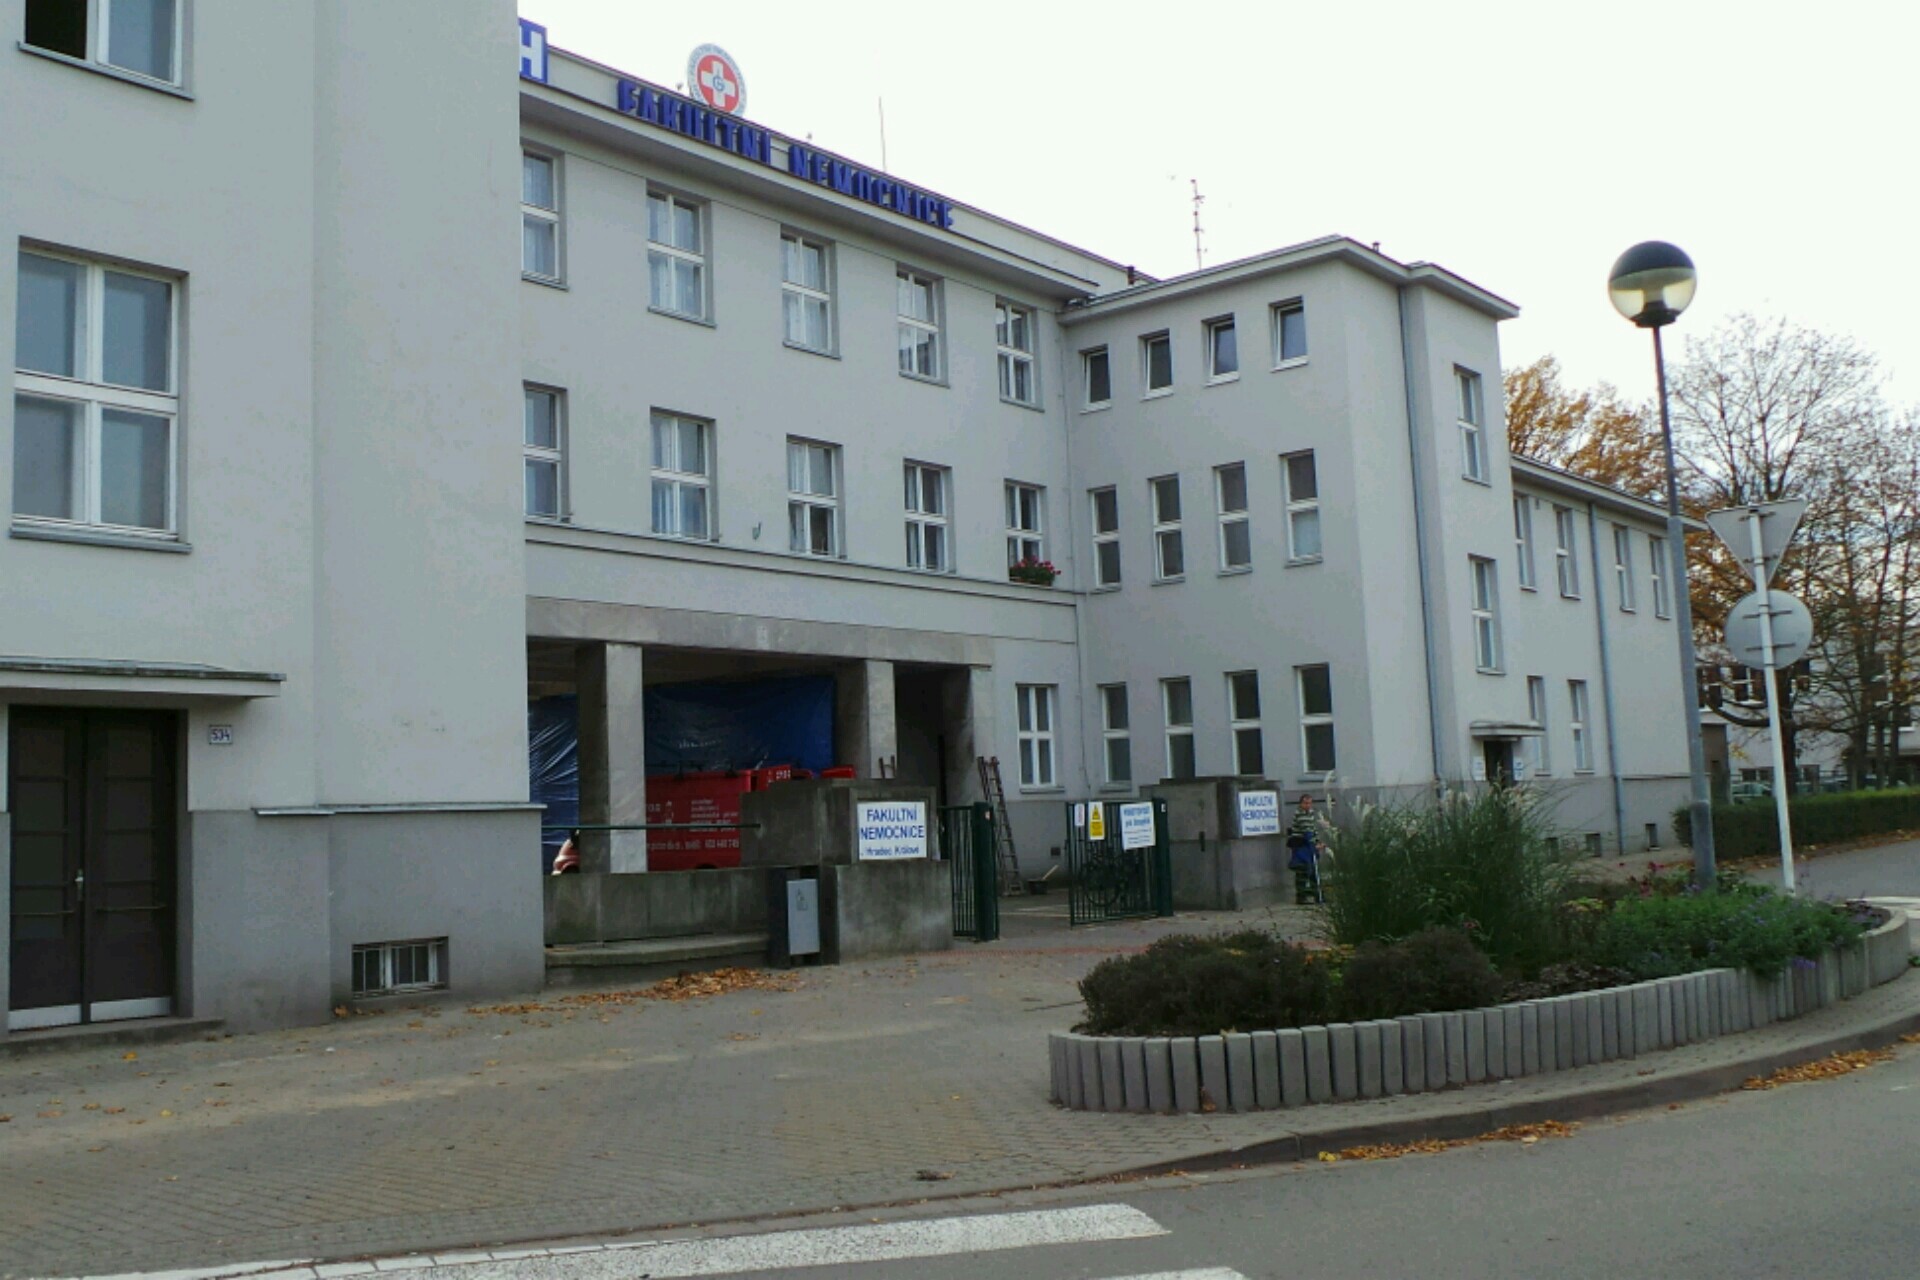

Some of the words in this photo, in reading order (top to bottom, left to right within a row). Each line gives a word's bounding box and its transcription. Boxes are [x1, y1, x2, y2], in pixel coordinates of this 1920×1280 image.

[788, 144, 954, 229] NEMOCNICE
[867, 804, 917, 821] FAKULTNÍ
[860, 826, 924, 840] NEMOCNICE
